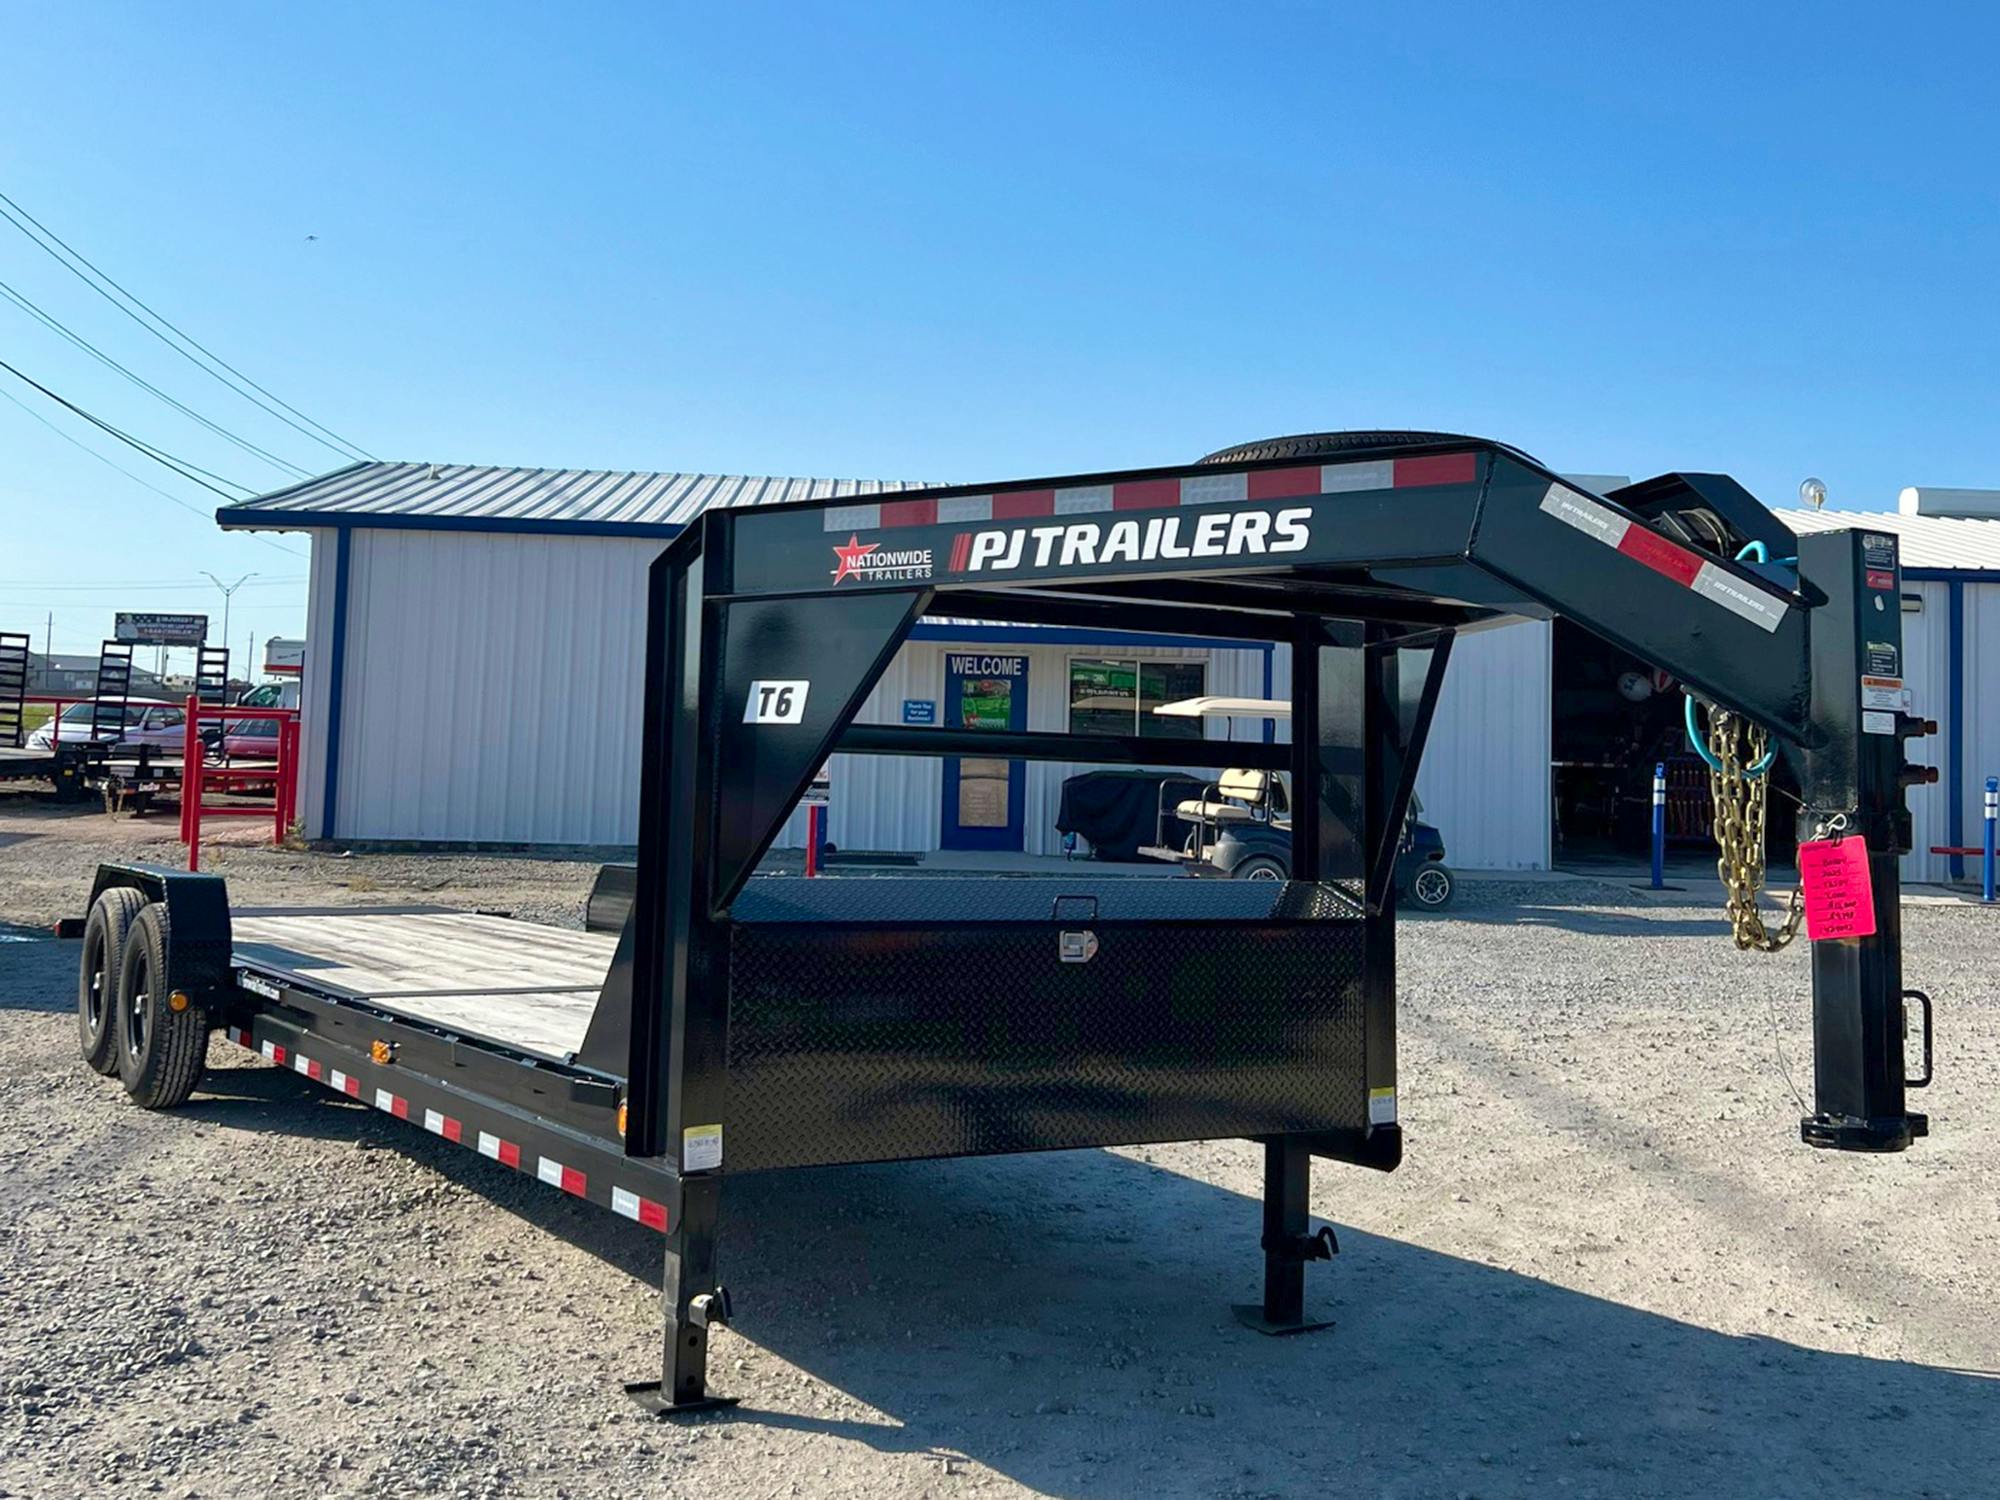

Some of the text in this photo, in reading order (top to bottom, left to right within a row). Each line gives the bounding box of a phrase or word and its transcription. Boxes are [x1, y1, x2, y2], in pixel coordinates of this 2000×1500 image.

[1031, 507, 1313, 568] TRAILERS
[845, 549, 933, 569] NATIONWIDE
[867, 567, 933, 581] TRAILERS
[951, 656, 1022, 676] WELCOME
[759, 686, 795, 718] T6
